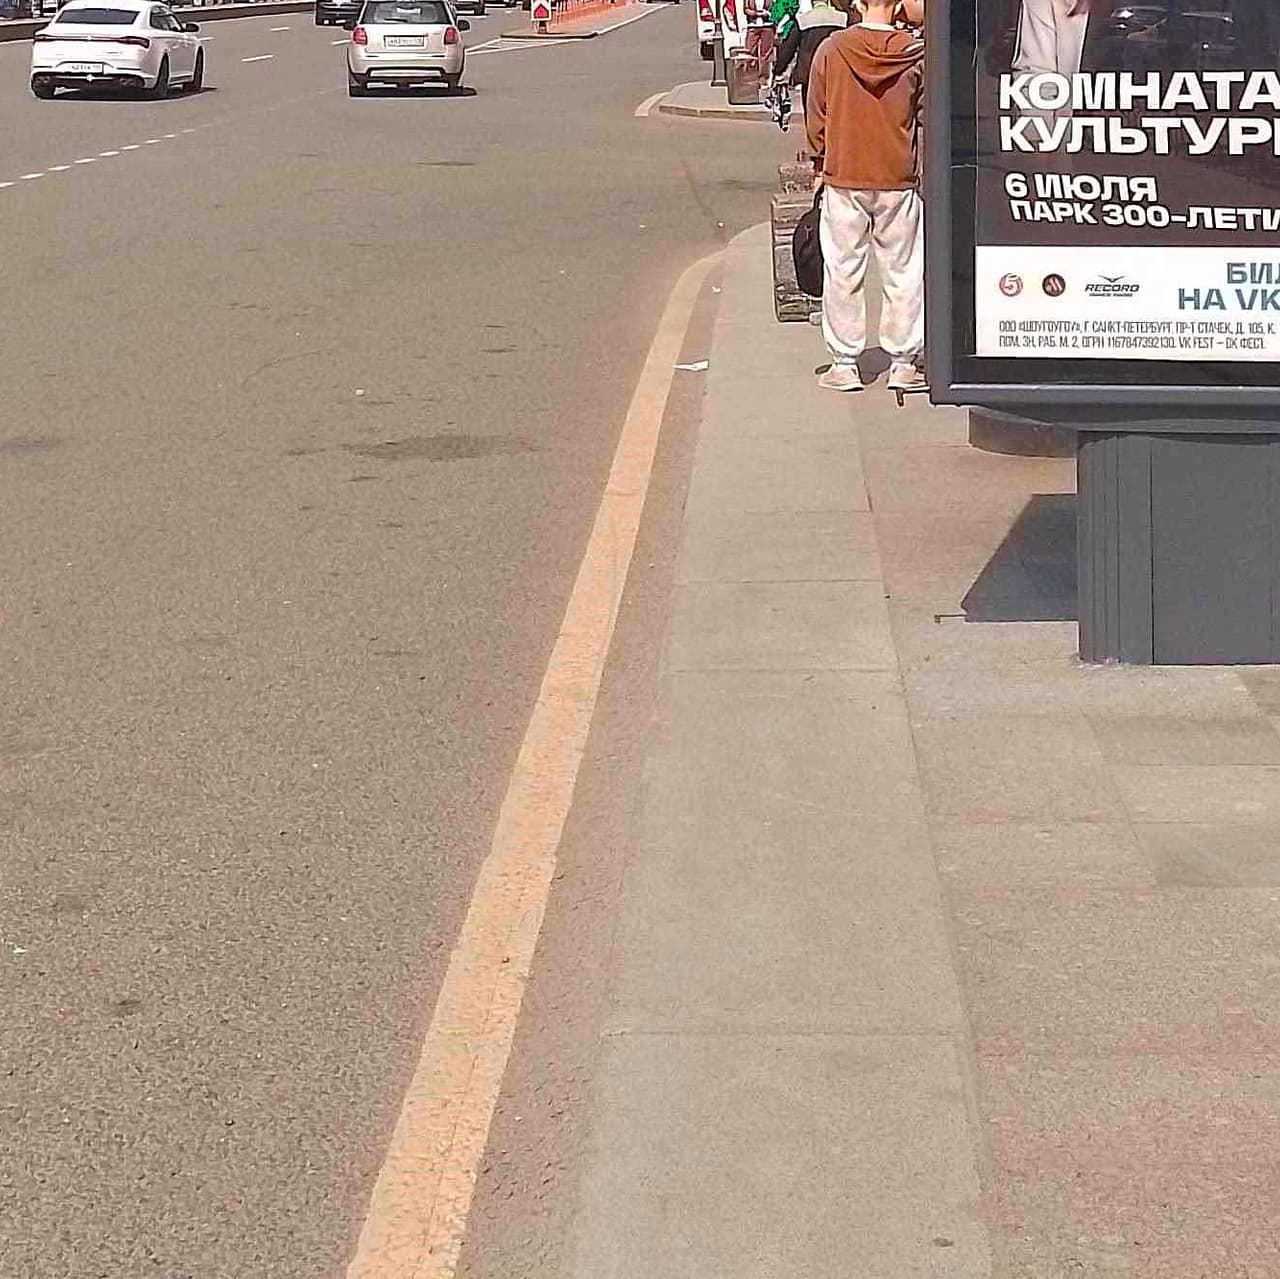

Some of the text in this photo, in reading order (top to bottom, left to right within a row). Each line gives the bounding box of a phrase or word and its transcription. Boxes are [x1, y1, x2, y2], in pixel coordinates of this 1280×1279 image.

[1004, 172, 1158, 202] 6 ИЮЛЯ
[1009, 199, 1099, 224] ПАРК
[1084, 283, 1141, 293] RECORD
[1177, 288, 1227, 311] НА
[999, 320, 1017, 333] ООО
[1175, 322, 1197, 334] ПР-Т
[1197, 322, 1234, 336] СТАЧЕК,
[1081, 337, 1105, 349] ОГРН
[1178, 337, 1192, 349] VK
[1193, 337, 1214, 349] FEST
